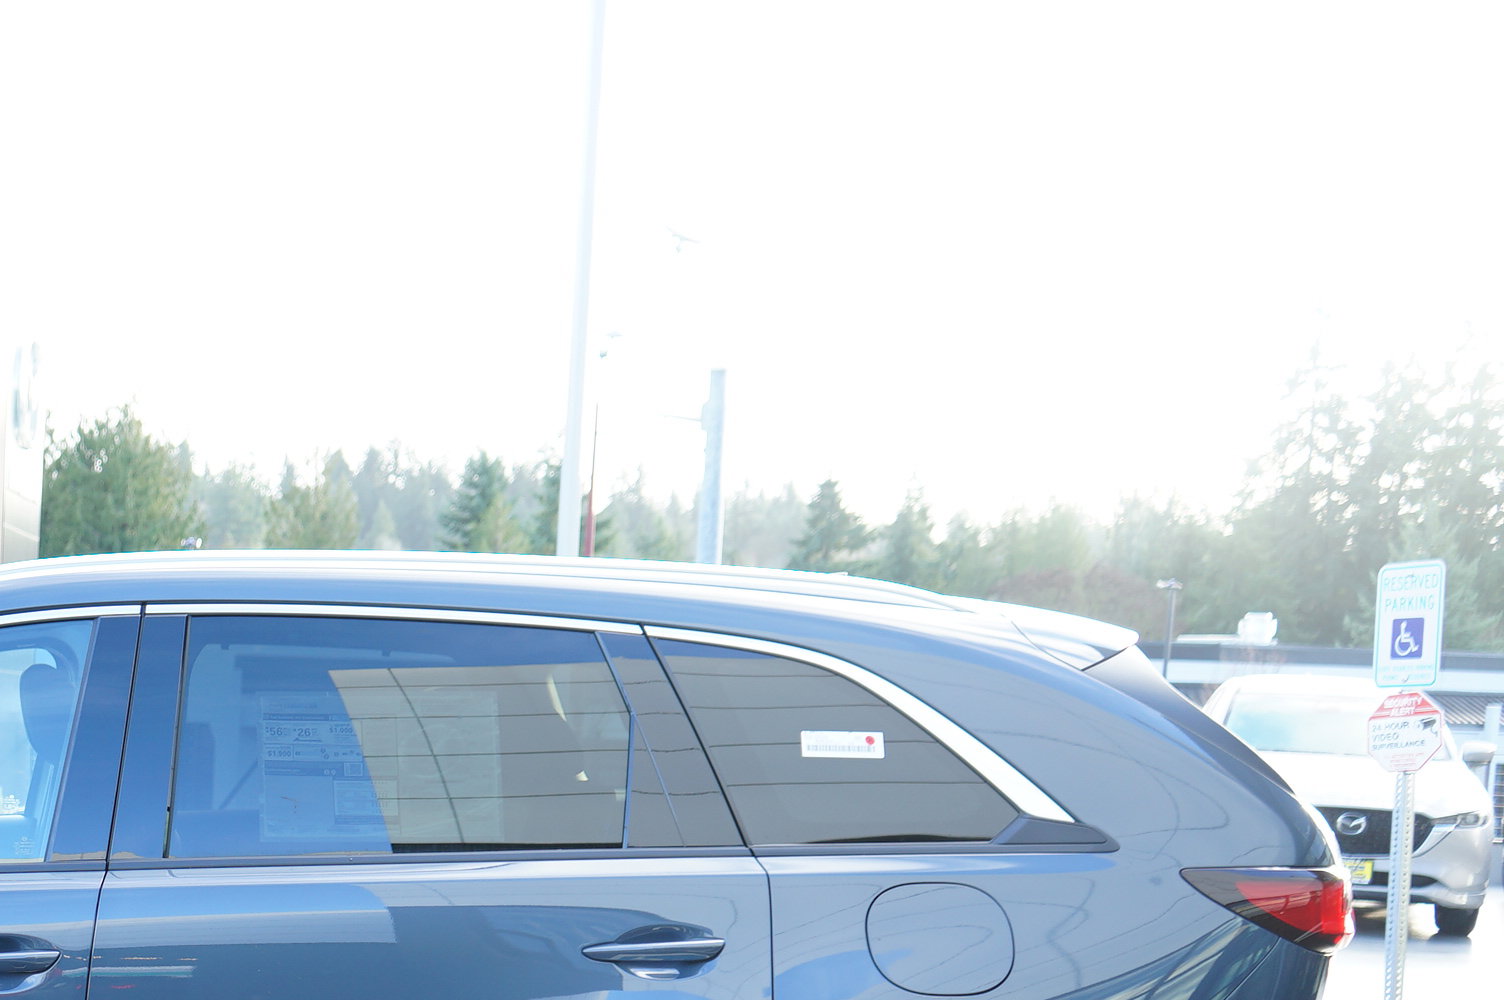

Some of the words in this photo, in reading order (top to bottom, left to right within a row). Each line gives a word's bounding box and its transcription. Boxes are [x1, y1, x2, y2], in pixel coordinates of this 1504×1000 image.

[1383, 573, 1439, 592] RESERVED
[1384, 594, 1435, 611] PARKING
[1384, 721, 1409, 732] HOUR
[1372, 733, 1400, 742] VIDEO
